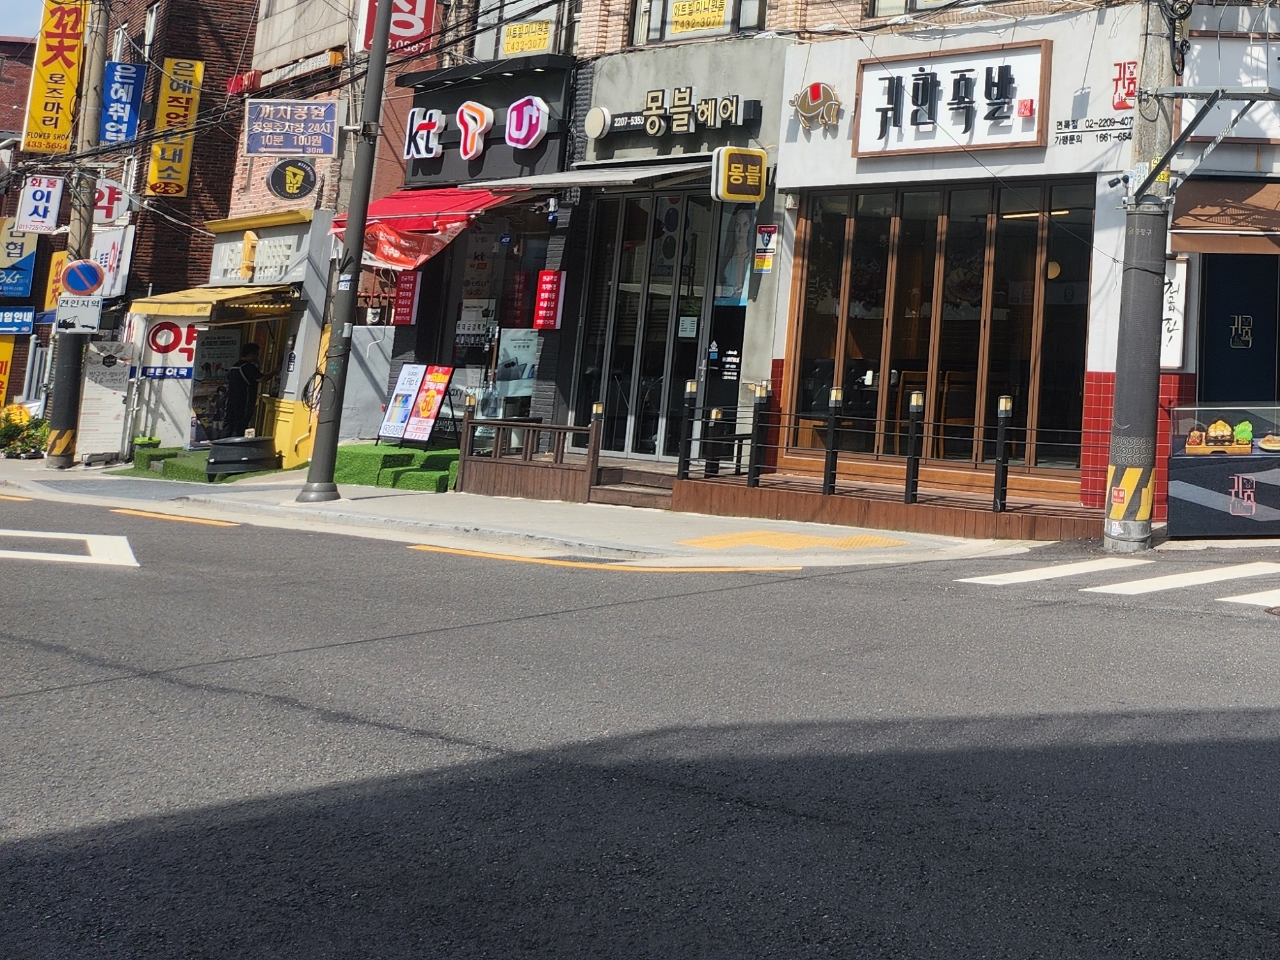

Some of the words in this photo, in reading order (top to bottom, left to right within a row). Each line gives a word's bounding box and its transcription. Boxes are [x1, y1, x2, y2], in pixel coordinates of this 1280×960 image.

[42, 5, 85, 70] 꽃
[41, 72, 67, 130] 로즈마리
[874, 65, 1016, 141] 귀한족발
[260, 104, 325, 121] 까치공원
[613, 115, 645, 127] 2207-5353
[1056, 119, 1079, 131] 면목점
[27, 131, 51, 140] FLOWER
[403, 107, 443, 159] kt
[1055, 133, 1083, 145] 가맹문의
[261, 135, 284, 146] 10분
[292, 135, 322, 147] 100원
[728, 162, 761, 187] 몽블
[29, 177, 58, 188] 화물
[155, 182, 180, 195] 2층
[28, 189, 51, 220] 이사
[60, 299, 100, 308] 견인지역
[147, 321, 199, 363] 약
